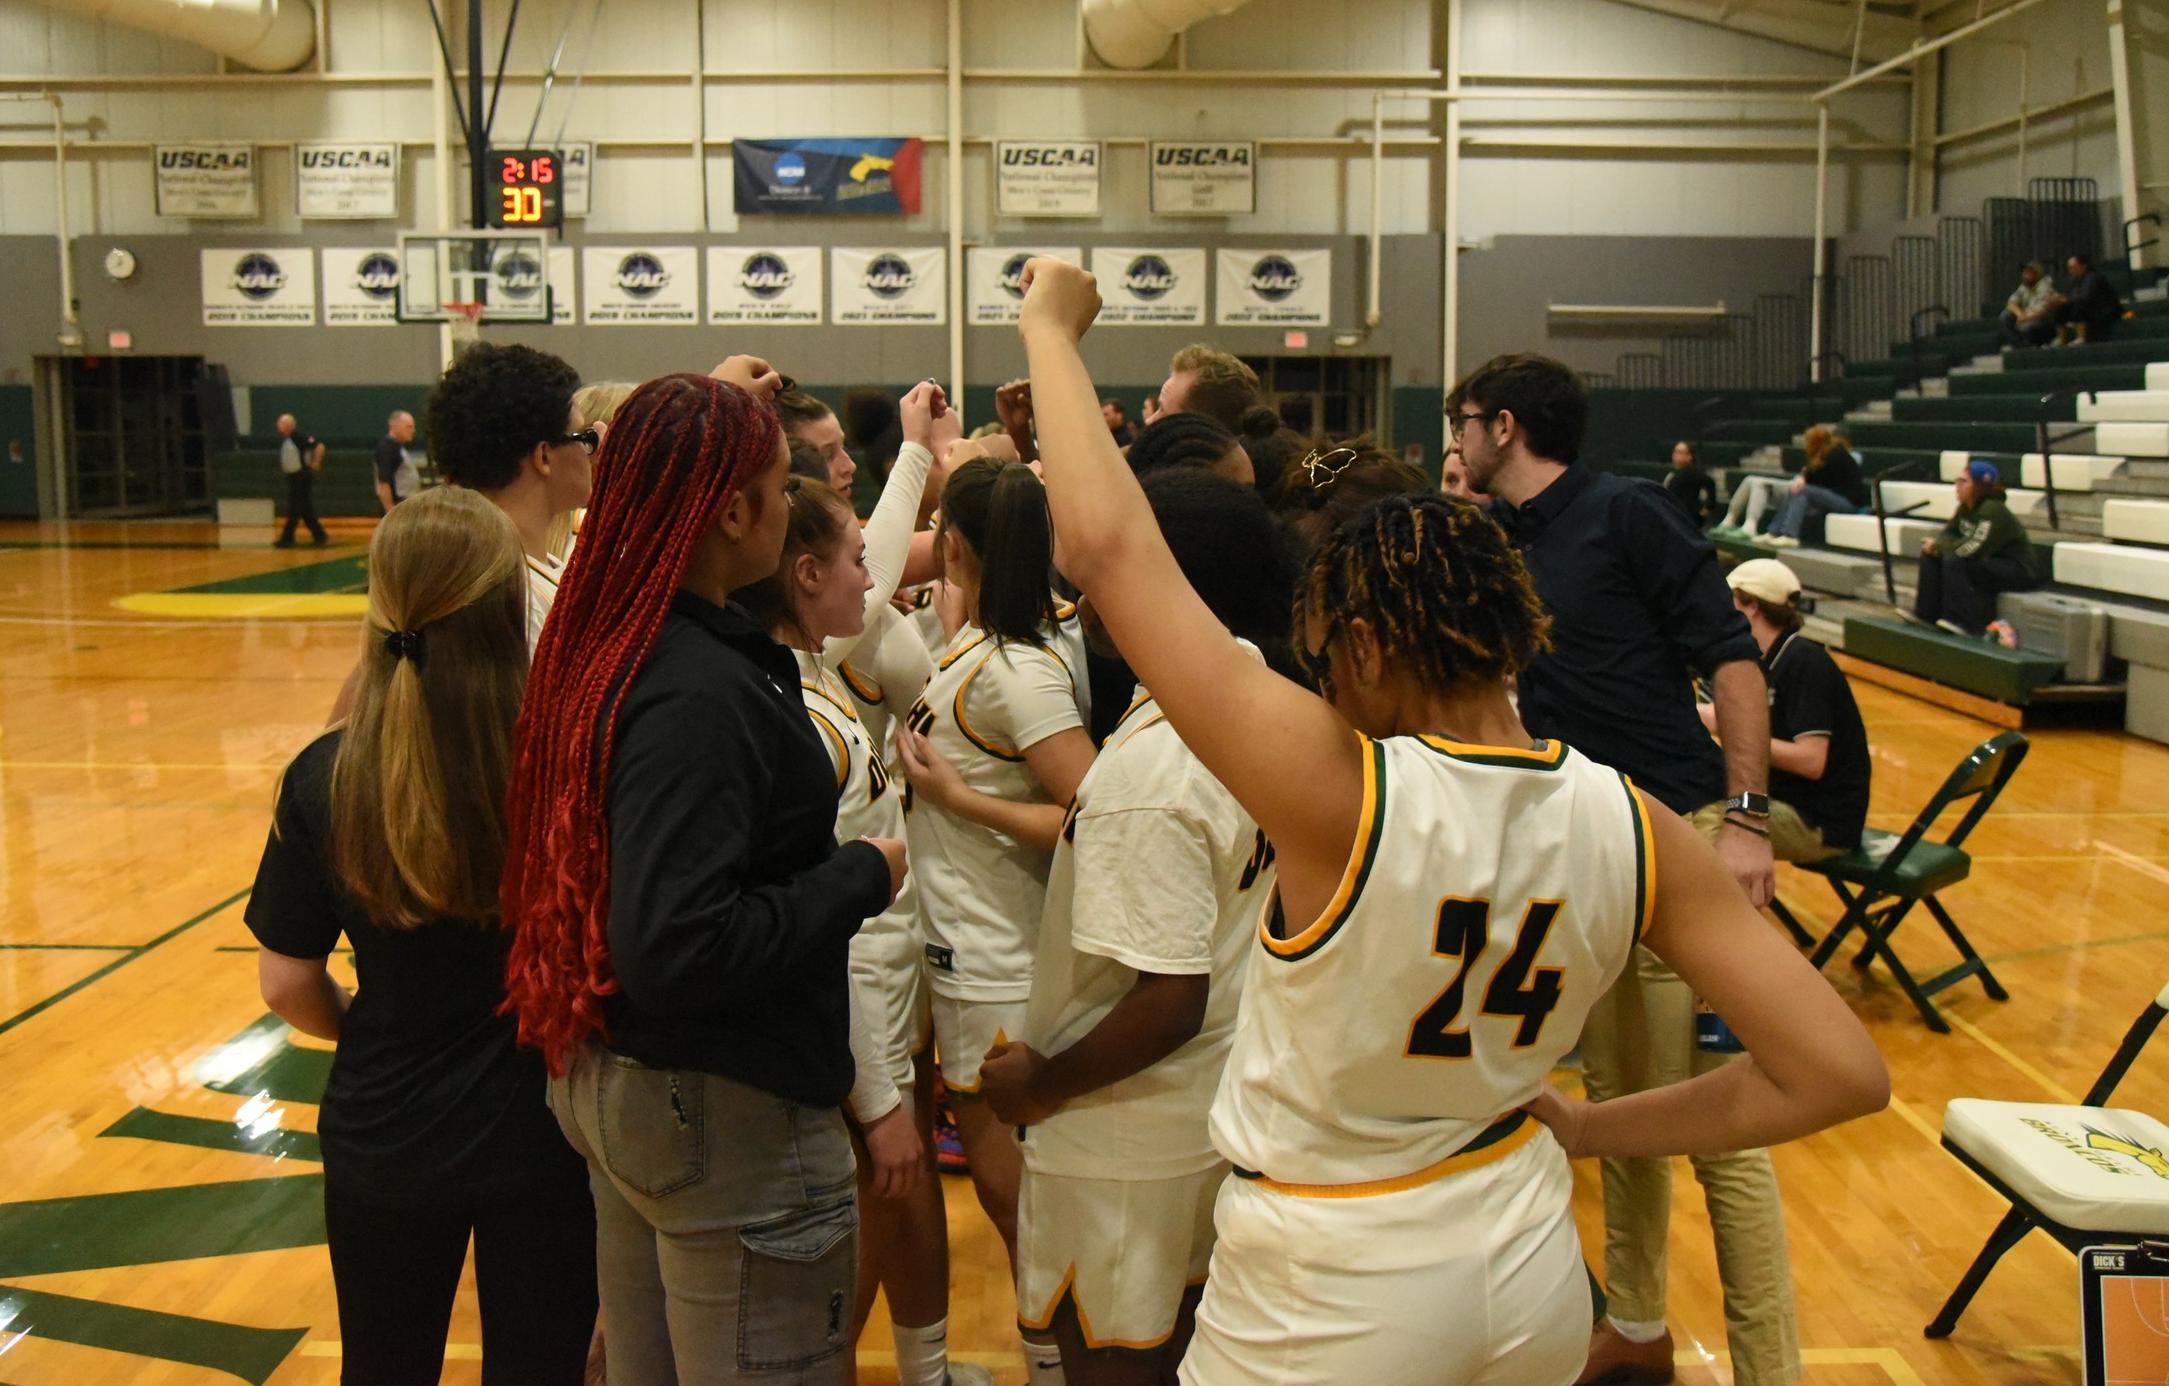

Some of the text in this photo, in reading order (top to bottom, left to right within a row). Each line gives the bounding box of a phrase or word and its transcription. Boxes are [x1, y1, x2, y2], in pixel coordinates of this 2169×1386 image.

[161, 151, 248, 169] USCAA
[303, 150, 390, 169] USCAA
[1004, 148, 1094, 166] USCAA
[1157, 147, 1248, 166] USCAA
[502, 157, 554, 183] 2:15
[502, 187, 541, 221] 30
[228, 273, 288, 289] NAC
[610, 272, 672, 288] NAC
[734, 272, 796, 288] NAC
[859, 273, 918, 288] NAC
[1119, 274, 1178, 290] NAC
[1244, 275, 1303, 290] NAC
[1402, 895, 1567, 1060] 24
